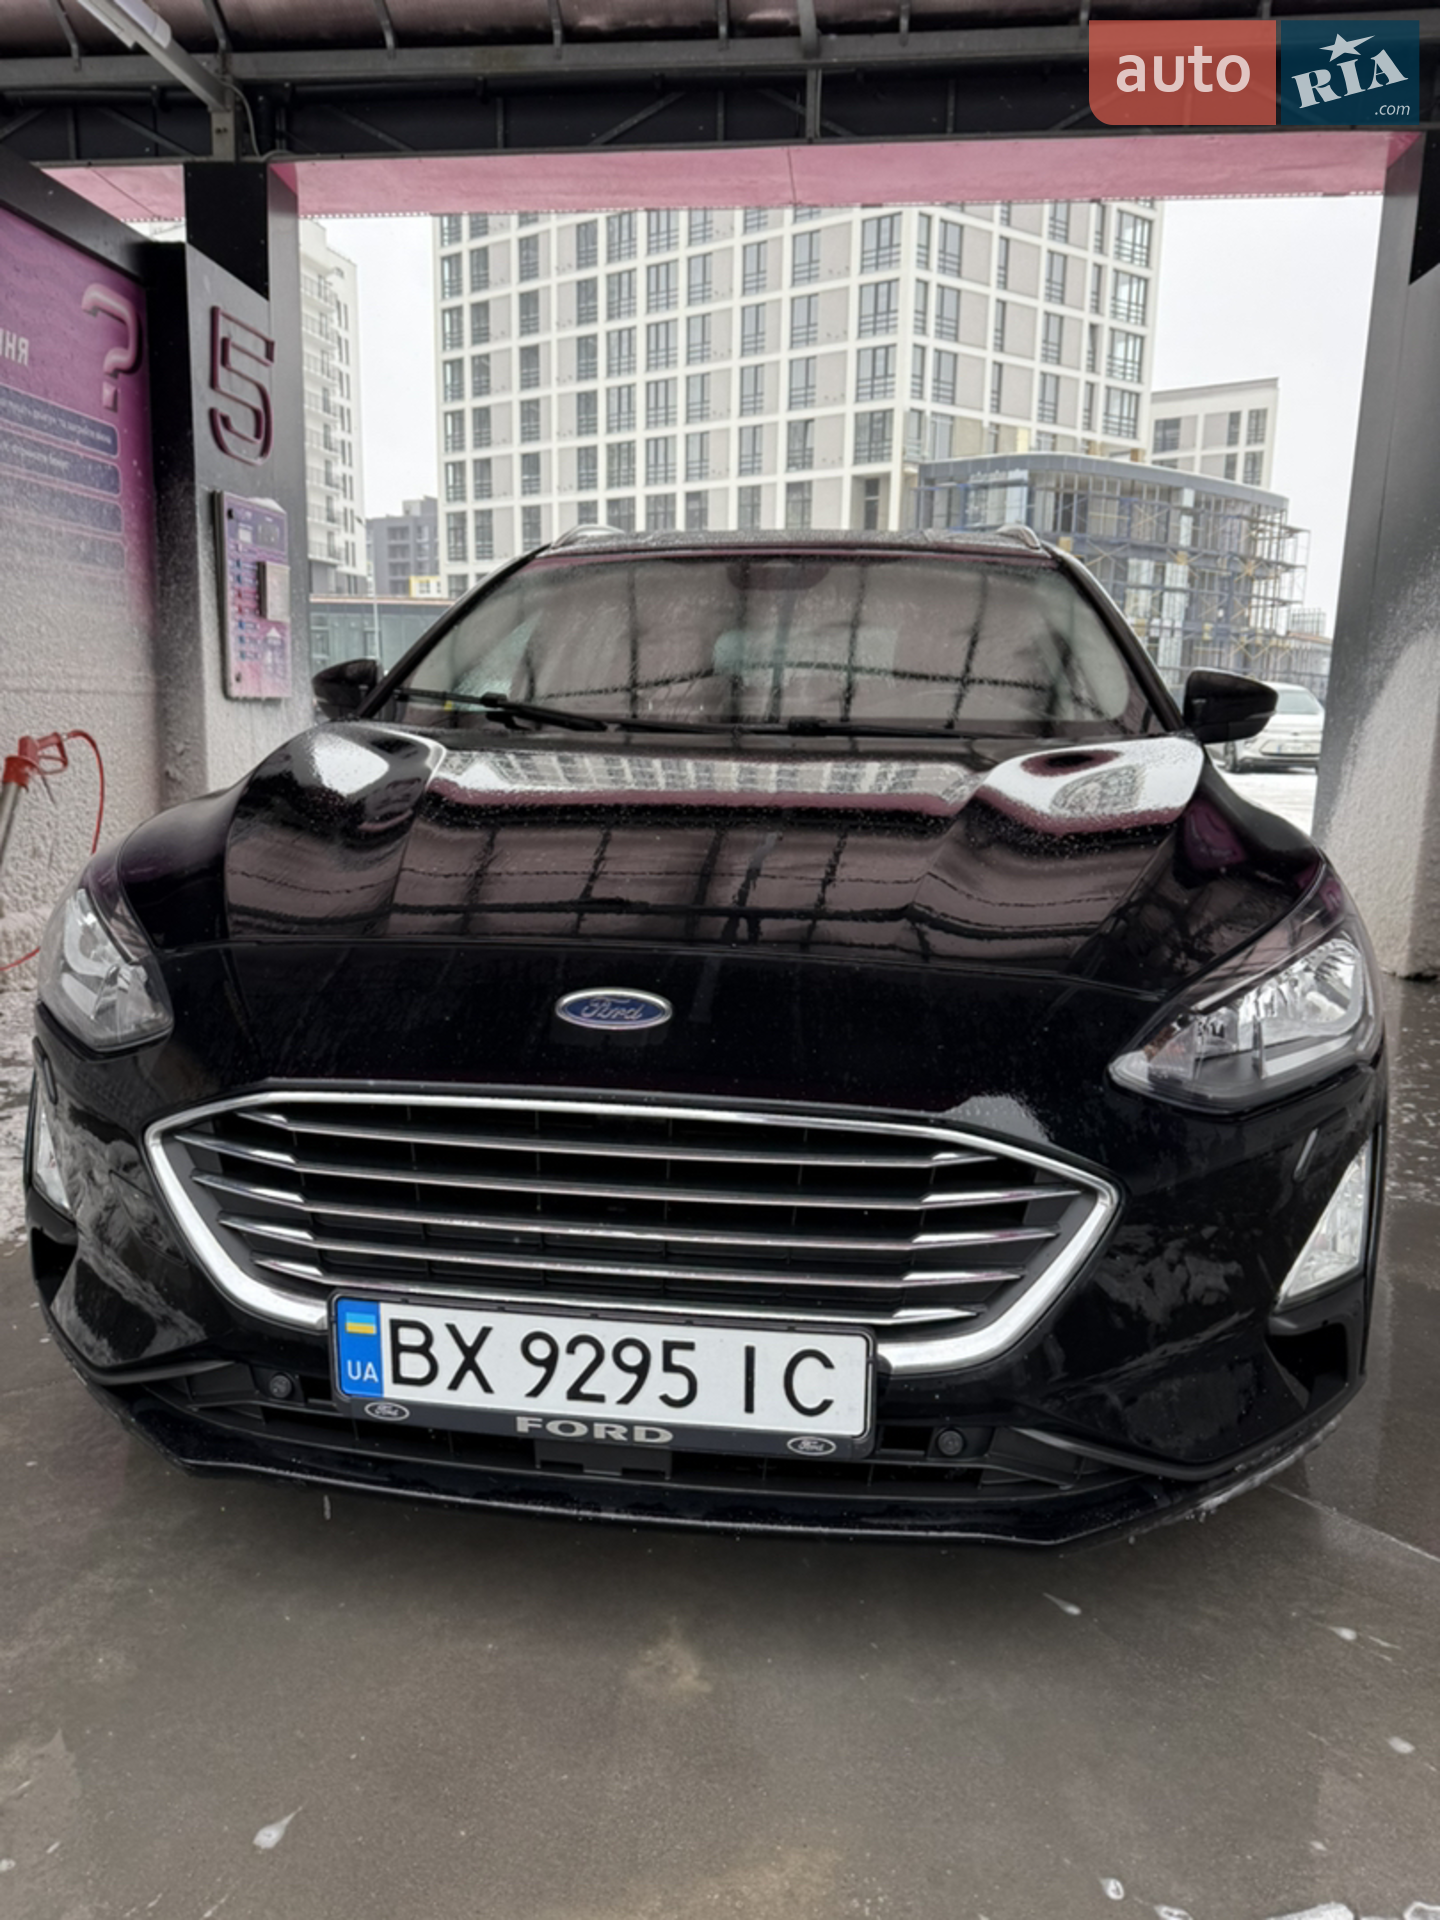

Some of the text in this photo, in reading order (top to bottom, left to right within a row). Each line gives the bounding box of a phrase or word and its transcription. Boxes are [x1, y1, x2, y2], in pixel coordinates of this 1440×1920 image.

[0, 327, 29, 367] НЯ
[209, 305, 275, 467] 5
[580, 996, 645, 1020] Ford
[347, 1360, 378, 1383] UA
[389, 1318, 836, 1417] BX 9295 IC
[515, 1415, 675, 1444] FORD
